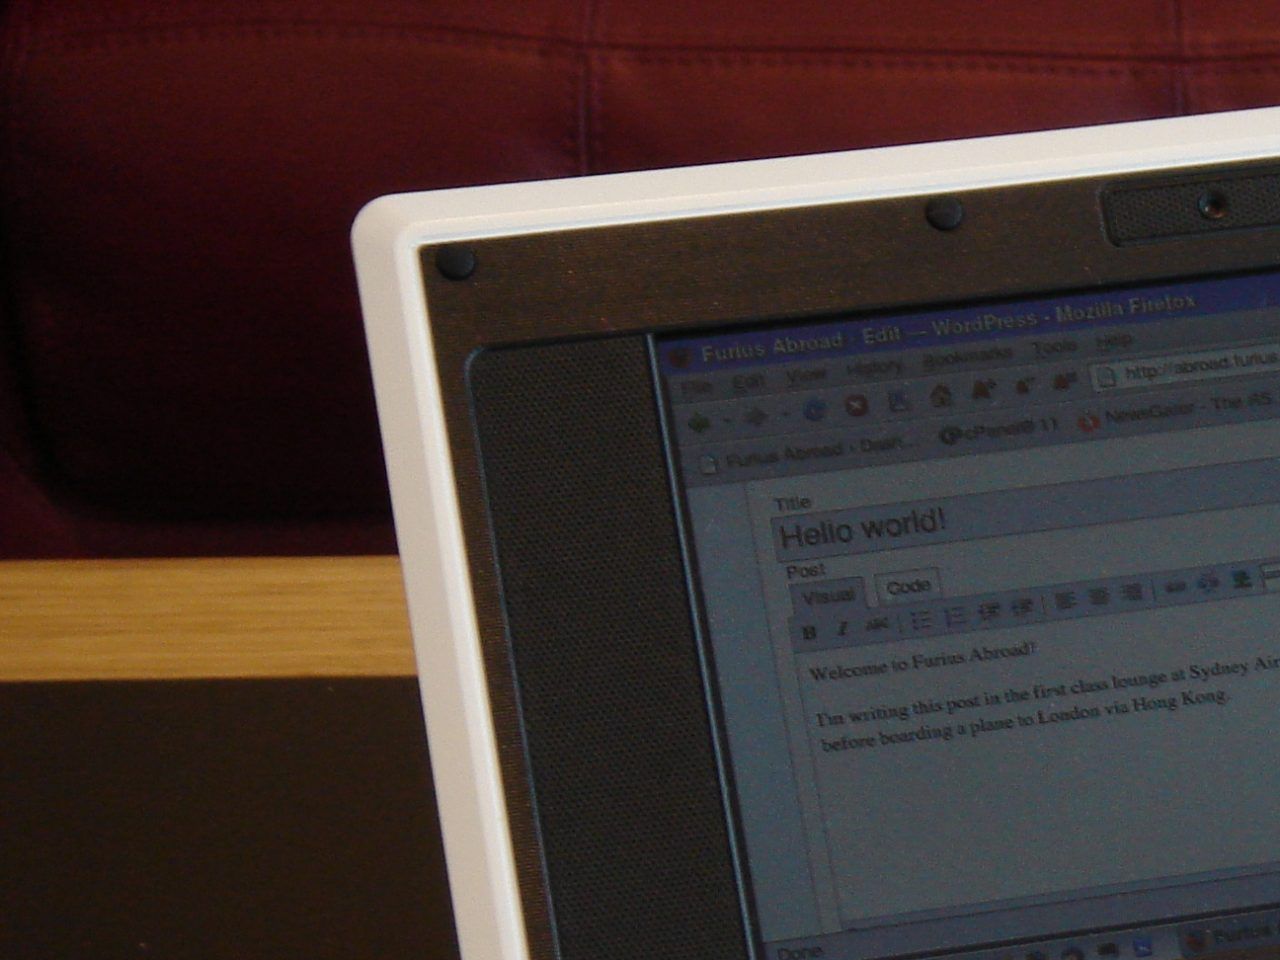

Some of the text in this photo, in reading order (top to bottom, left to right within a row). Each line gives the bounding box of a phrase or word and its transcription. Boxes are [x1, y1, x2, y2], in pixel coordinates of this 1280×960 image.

[702, 294, 1196, 363] Furius Abroad Edit WordPress Mozilla Firefox
[774, 496, 812, 512] Title
[780, 506, 947, 550] Hello world!
[786, 562, 827, 580] Post
[802, 577, 932, 605] Visual Code
[809, 661, 889, 683] Welcome
[892, 658, 909, 674] to
[912, 652, 966, 670] Furius
[816, 711, 844, 729] I'm
[848, 703, 910, 724] writing
[912, 697, 943, 716] this
[946, 694, 981, 715] post
[984, 690, 1001, 706] in
[1004, 686, 1030, 704] the
[1032, 682, 1068, 699] first
[1070, 677, 1110, 695] class
[1112, 671, 1168, 690] lounge
[1171, 667, 1187, 683] at
[1189, 660, 1249, 683] Sydney
[820, 733, 878, 753] before
[879, 725, 953, 748] boarding
[957, 722, 968, 737] a
[970, 715, 1015, 738] plane
[1018, 711, 1035, 727] to
[1037, 703, 1101, 725] London
[1105, 700, 1130, 717] via
[1132, 694, 1179, 715] Hong
